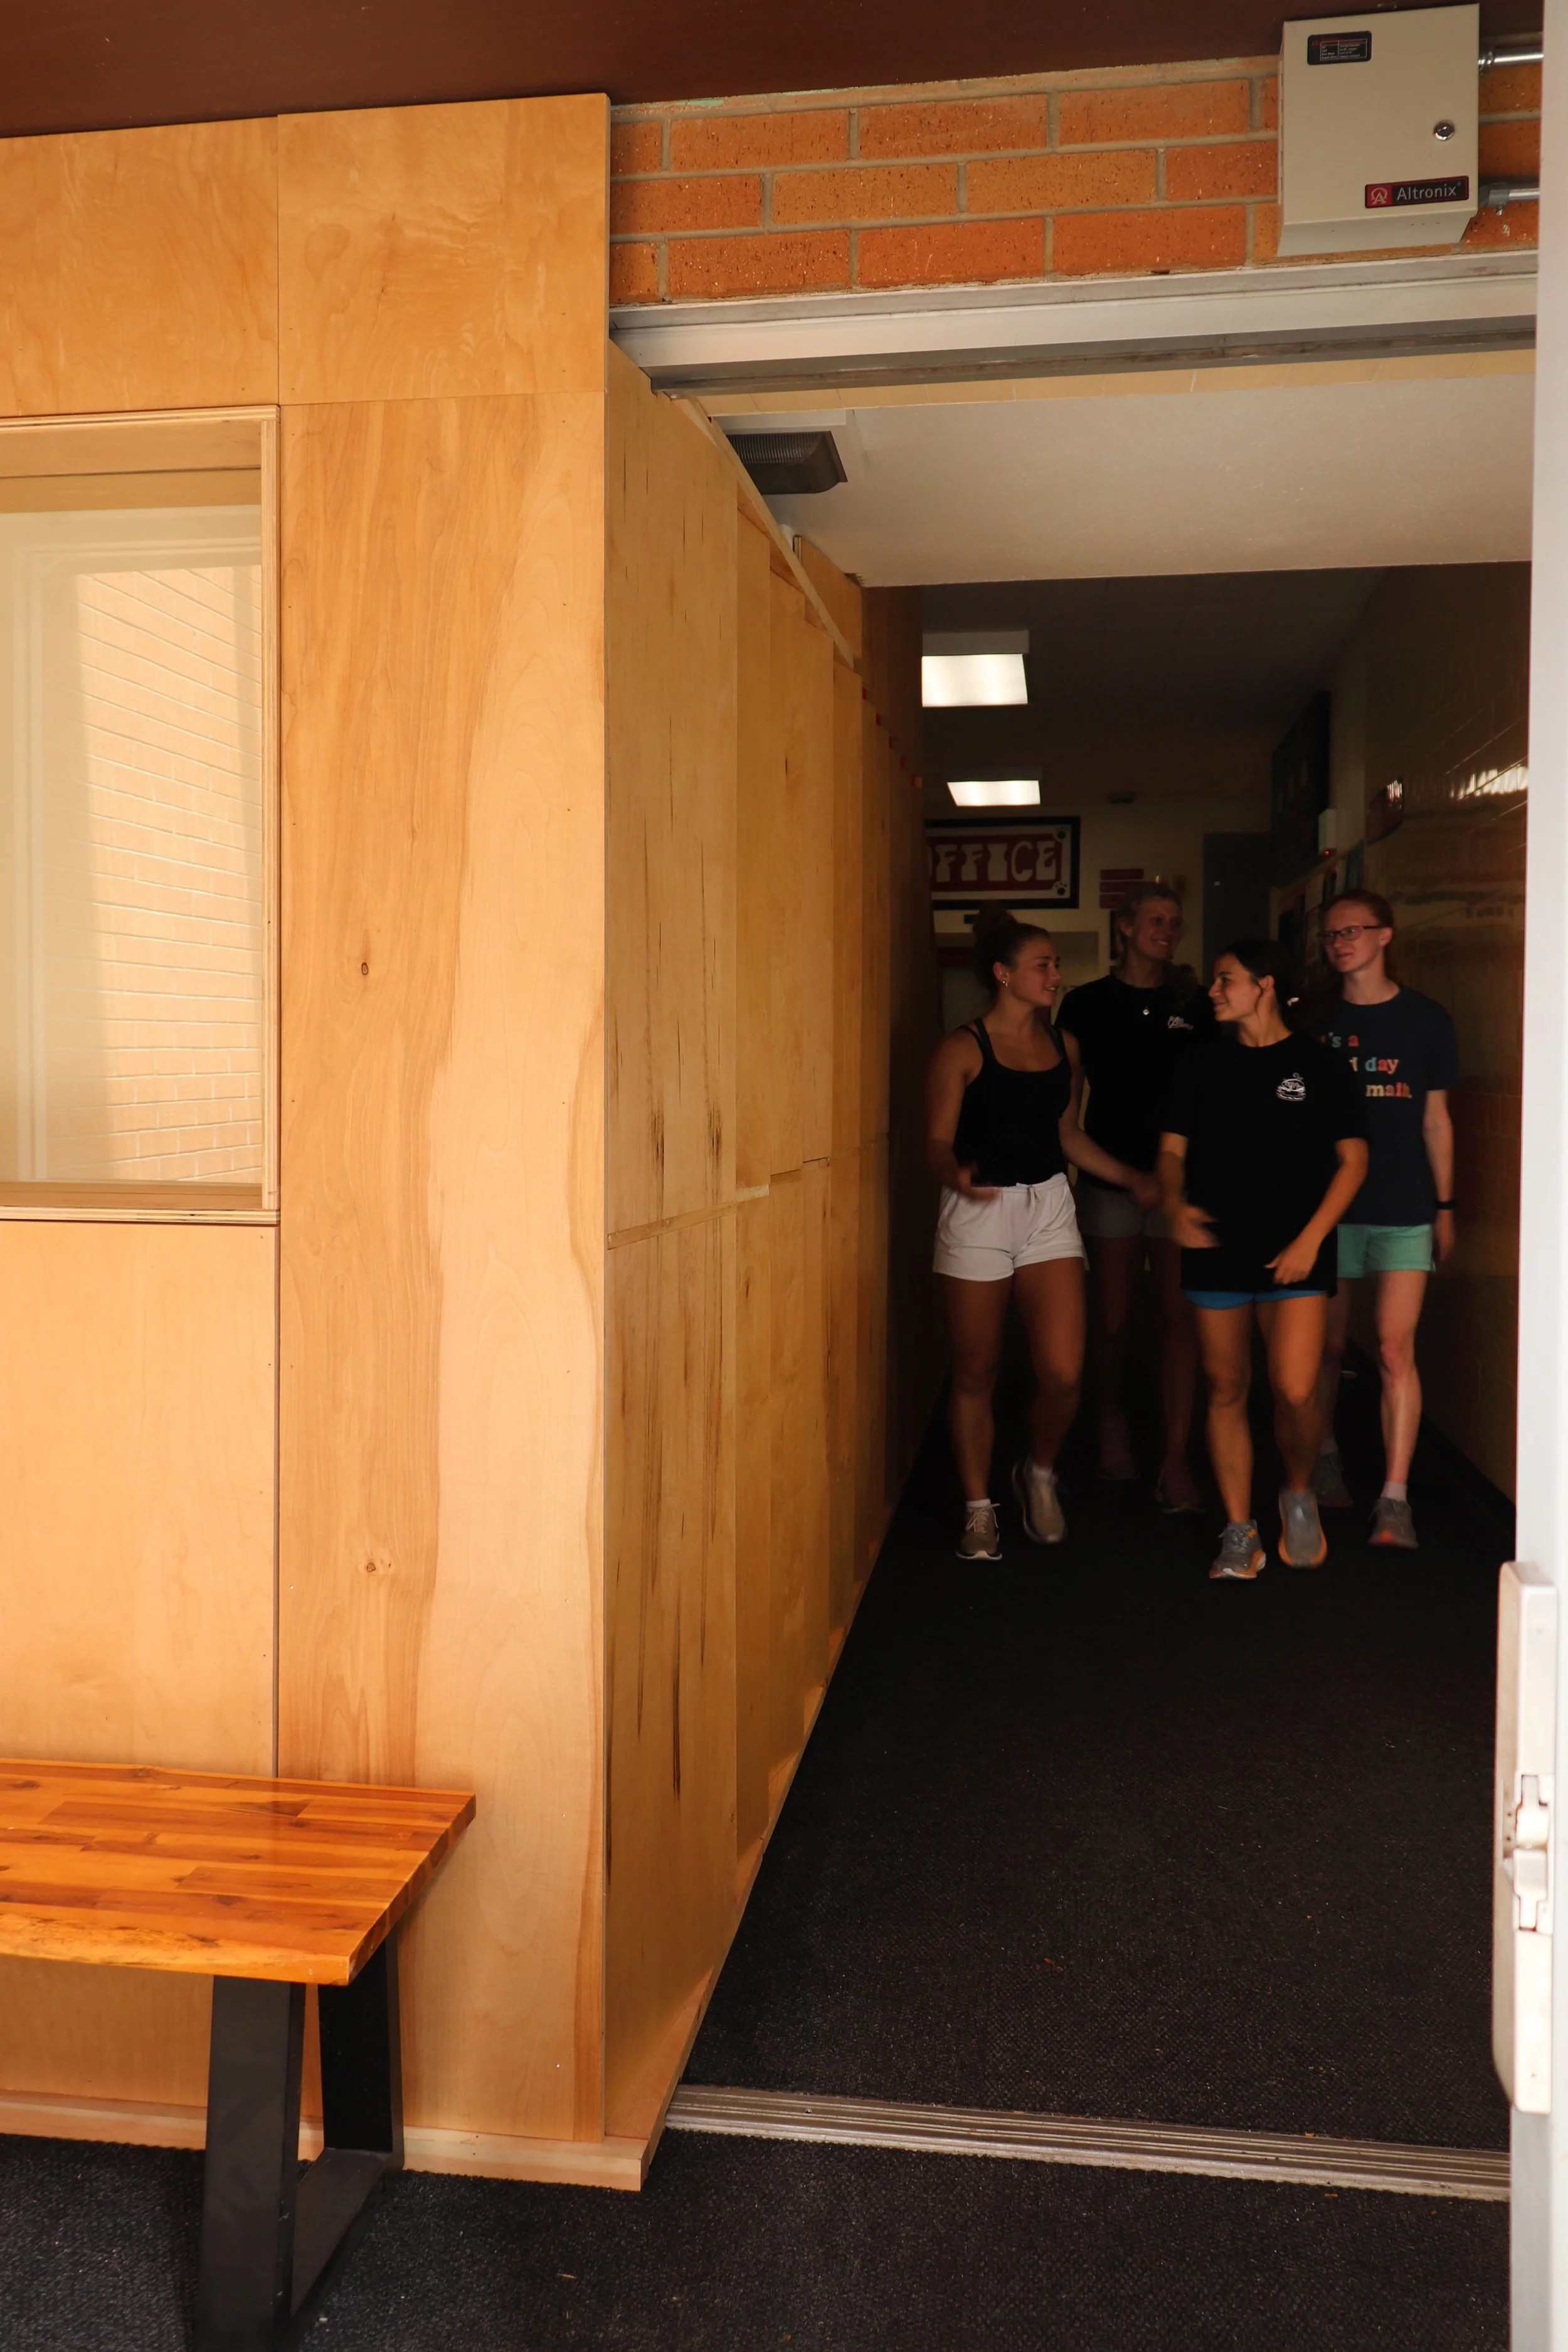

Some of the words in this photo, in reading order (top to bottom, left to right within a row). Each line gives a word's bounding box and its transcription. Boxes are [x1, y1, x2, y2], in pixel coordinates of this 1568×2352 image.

[1397, 184, 1456, 201] Altronix
[926, 840, 1057, 882] FFICE
[1364, 1056, 1400, 1075] day
